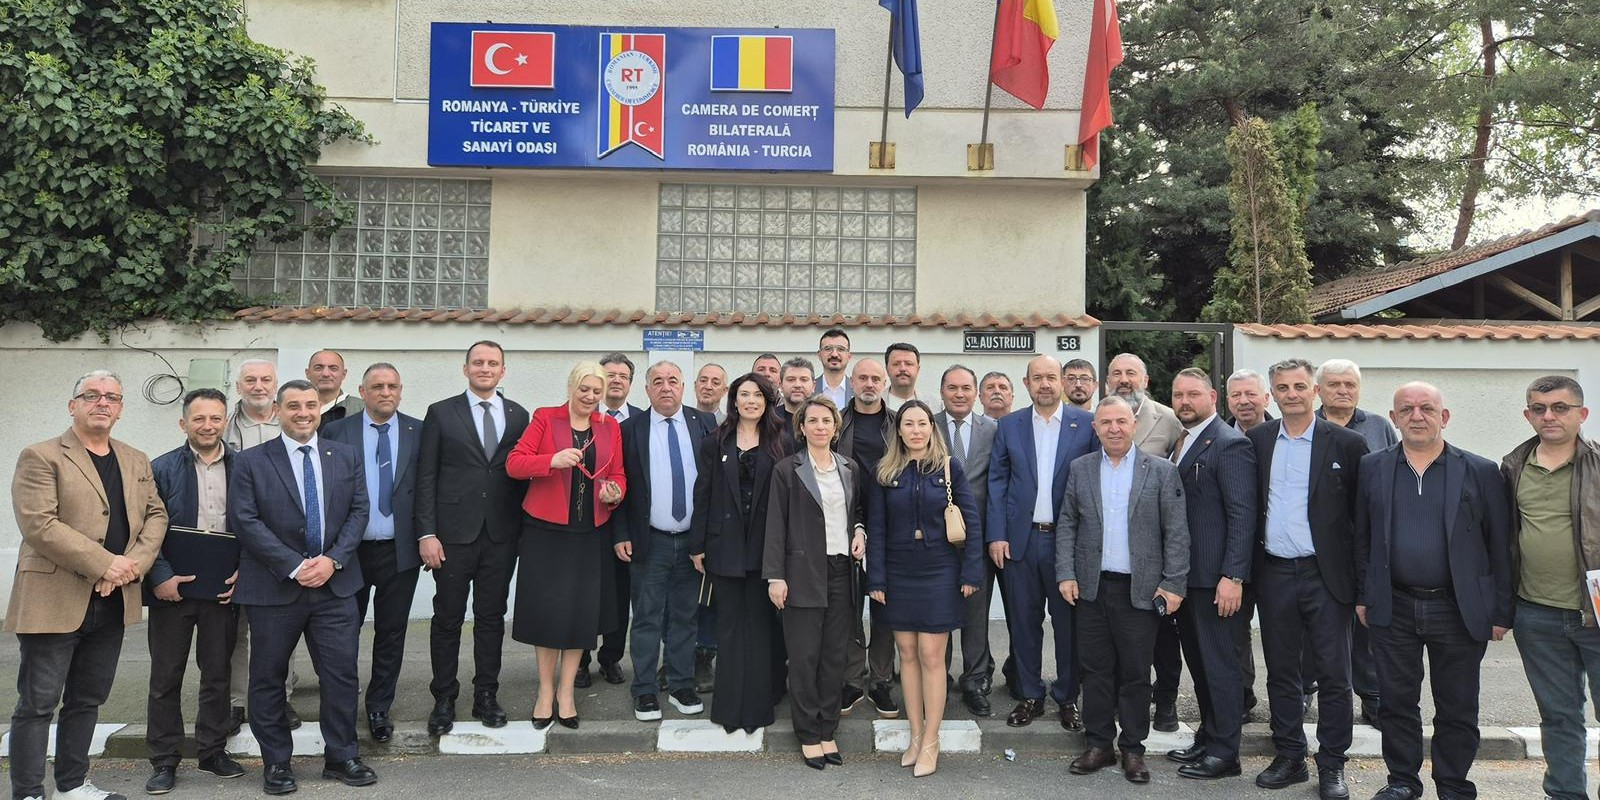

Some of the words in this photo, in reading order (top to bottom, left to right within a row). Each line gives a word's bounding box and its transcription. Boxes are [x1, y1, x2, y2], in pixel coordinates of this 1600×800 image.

[621, 68, 644, 82] RT
[442, 100, 508, 113] ROMANYA
[520, 99, 580, 114] TÜRKİYE
[681, 103, 738, 116] CAMERA
[741, 105, 759, 116] DE
[763, 105, 819, 121] COMERȚ
[471, 118, 529, 133] TİCARET
[533, 122, 551, 134] VE
[709, 122, 791, 137] BILATERALĂ
[462, 138, 512, 153] SANAYİ
[516, 142, 557, 154] ODASI
[687, 142, 750, 157] ROMÂNIA
[762, 145, 812, 157] TURCIA
[980, 336, 1030, 348] AUSTRULUI
[1062, 338, 1077, 349] 58
